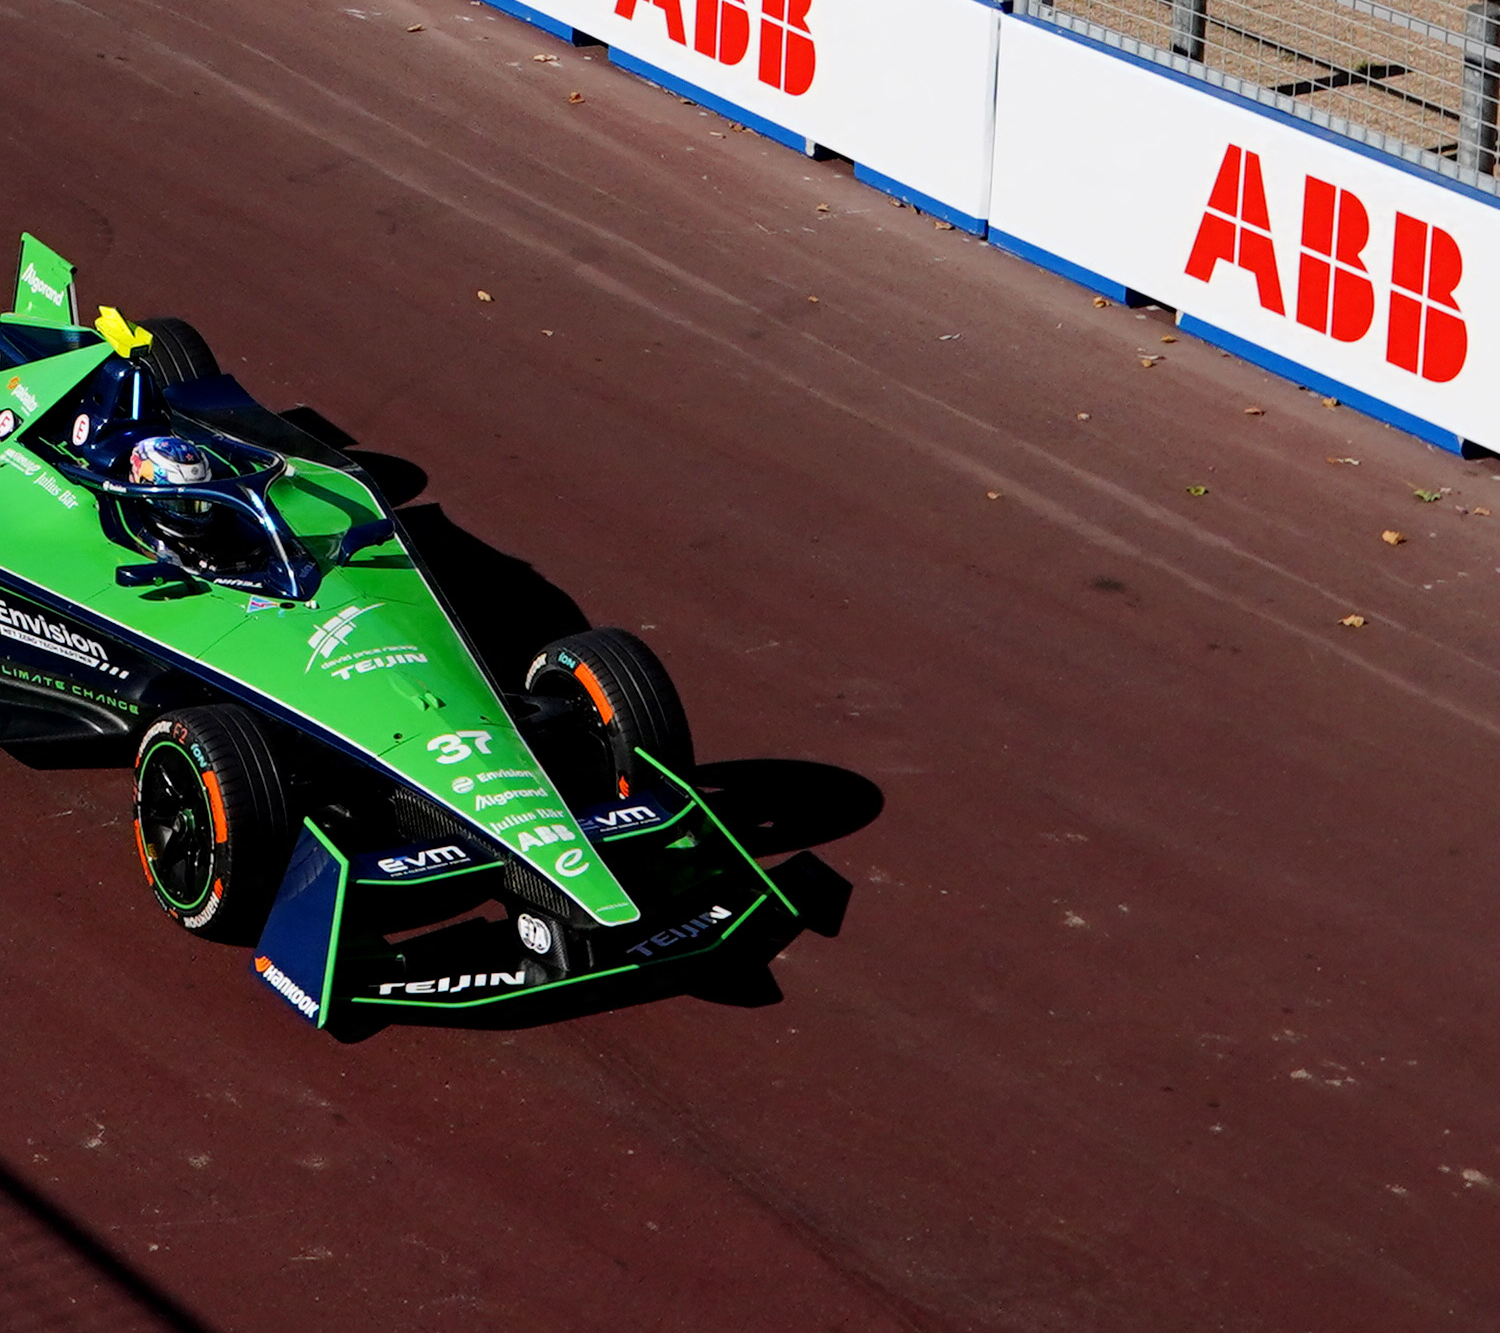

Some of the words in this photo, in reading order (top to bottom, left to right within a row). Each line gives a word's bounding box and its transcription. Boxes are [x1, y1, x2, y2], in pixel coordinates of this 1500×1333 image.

[1182, 142, 1470, 385] ABB
[331, 653, 429, 681] TEIJIN
[71, 684, 140, 716] CHANGE
[427, 730, 493, 765] 37
[476, 768, 535, 783] Envision
[475, 786, 550, 812] Algorand
[489, 812, 538, 835] Julius
[517, 823, 577, 853] ABB
[378, 970, 526, 996] TEIJIN
